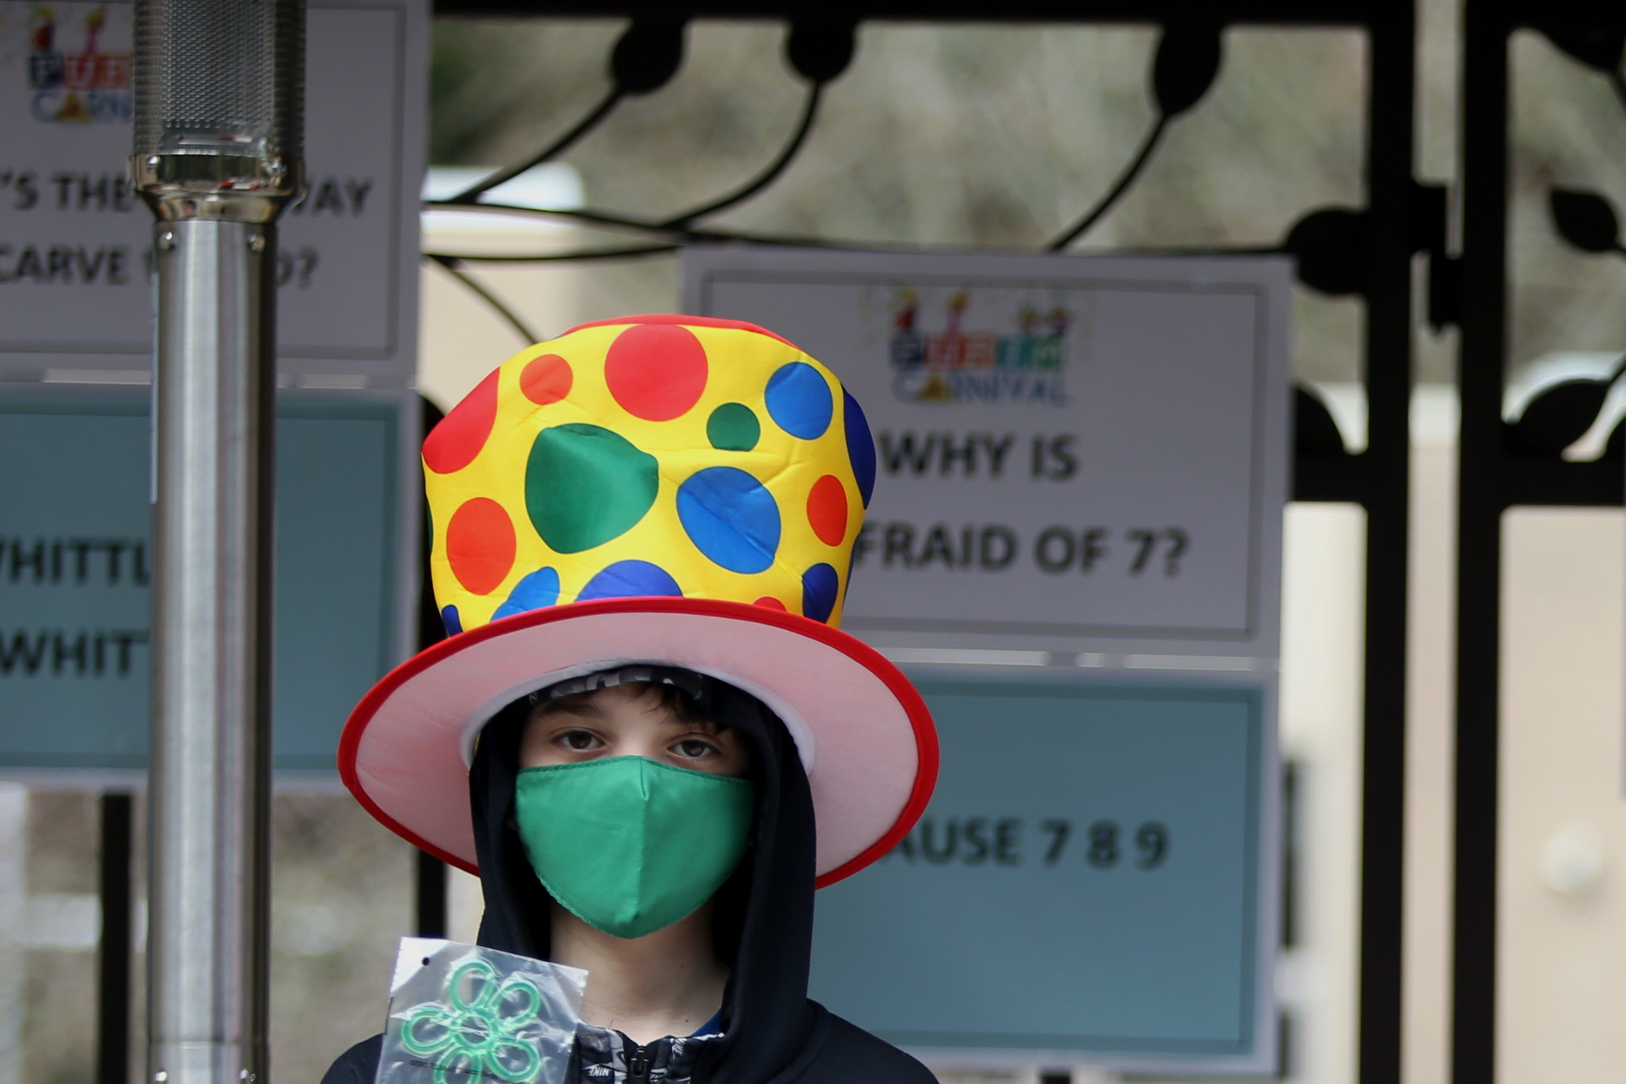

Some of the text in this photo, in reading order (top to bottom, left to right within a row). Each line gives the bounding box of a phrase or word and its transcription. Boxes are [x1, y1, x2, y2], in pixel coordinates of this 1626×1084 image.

[52, 173, 131, 212] THE
[880, 432, 1078, 481] WHY IS
[0, 538, 149, 587] HITTL
[854, 522, 1189, 577] FRAID OF 7?
[0, 630, 149, 677] WHIT
[886, 816, 1169, 870] AUSE 7 8 9
